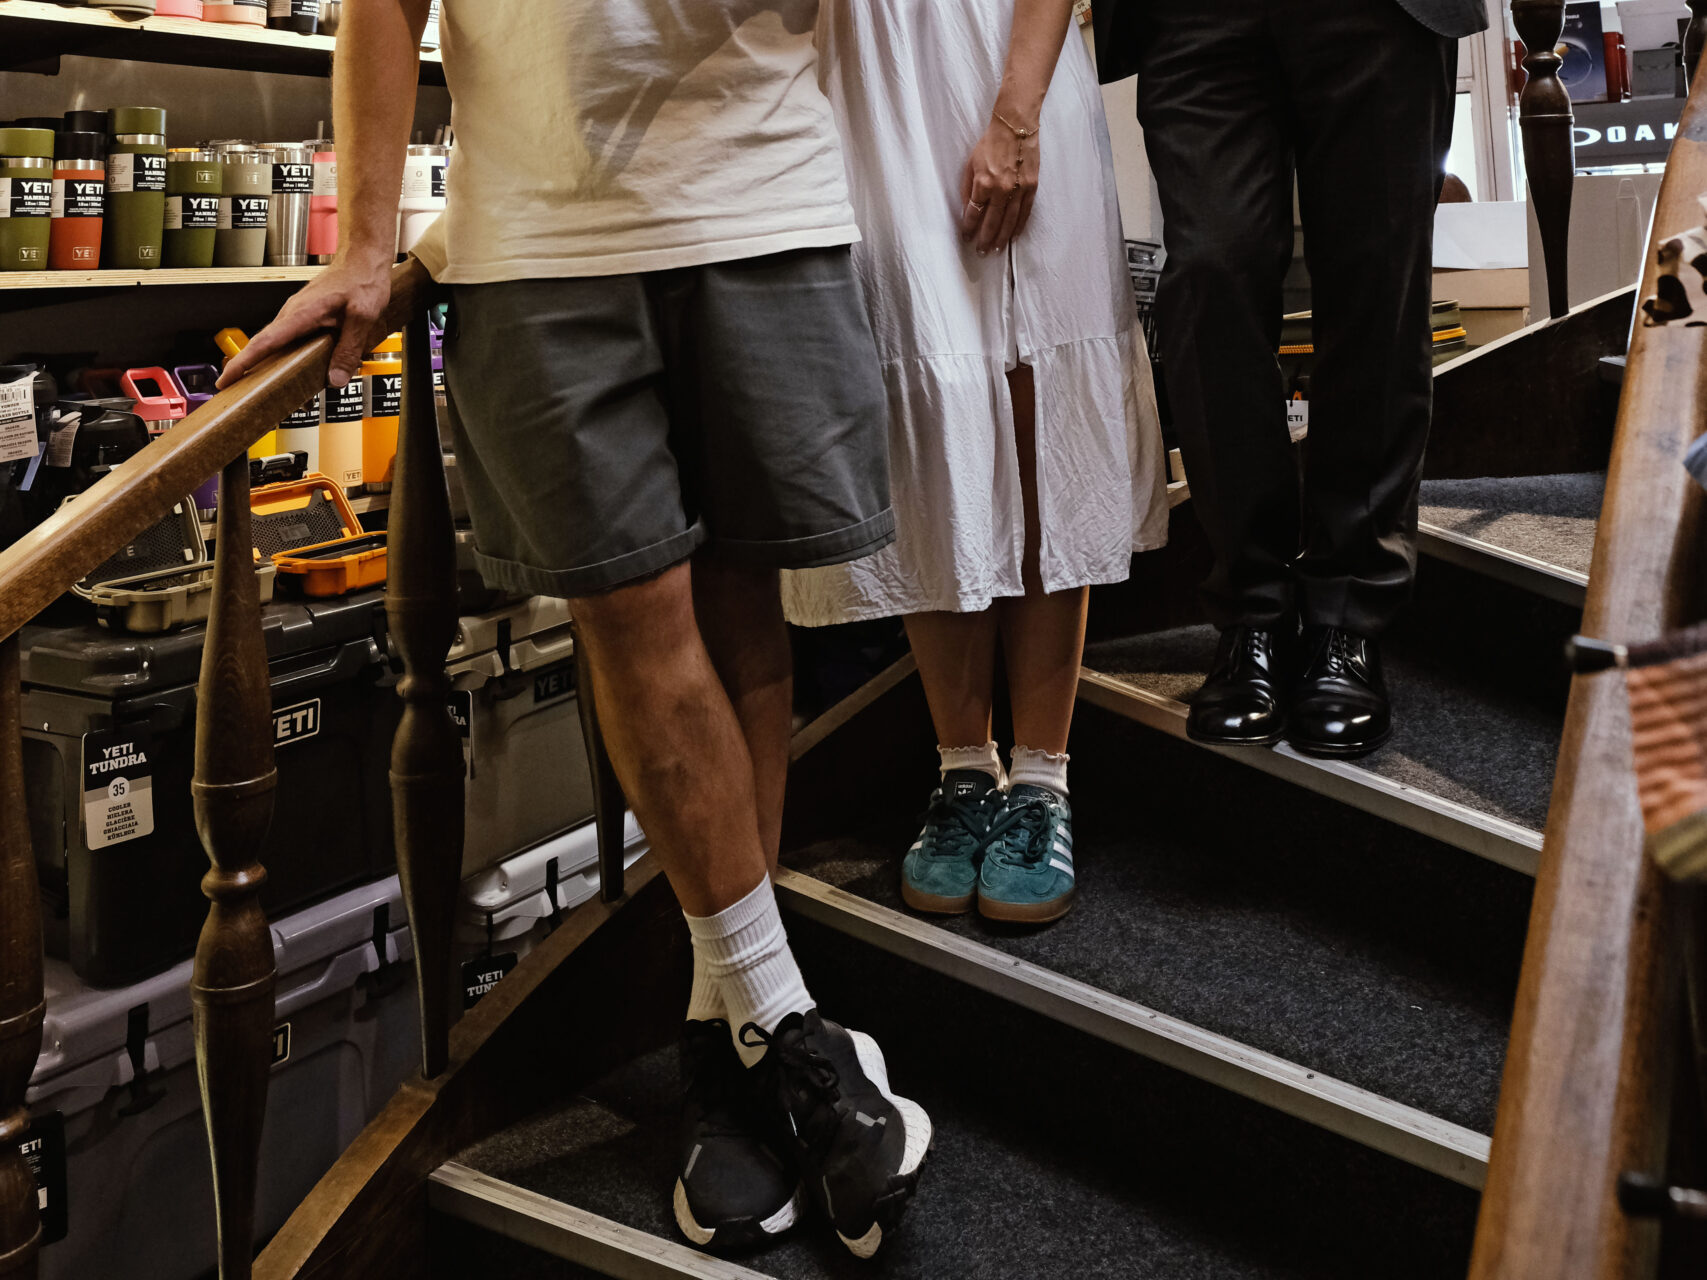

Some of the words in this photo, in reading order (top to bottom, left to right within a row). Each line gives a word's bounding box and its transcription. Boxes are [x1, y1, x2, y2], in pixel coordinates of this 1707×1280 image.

[1606, 122, 1681, 143] OAK
[280, 165, 311, 176] YETI
[21, 182, 52, 194] YETI
[74, 183, 104, 195] YETI
[189, 198, 219, 210] YETI
[239, 199, 269, 210] YETI
[383, 377, 402, 390] YE
[1288, 414, 1303, 422] ETI
[273, 707, 314, 739] ETI
[102, 742, 134, 759] YETI
[89, 752, 147, 775] TUNDRA
[113, 782, 125, 797] 35
[108, 802, 131, 813] COOLER
[477, 969, 504, 984] YETI
[466, 980, 499, 997] TUN
[18, 1138, 42, 1155] ETI
